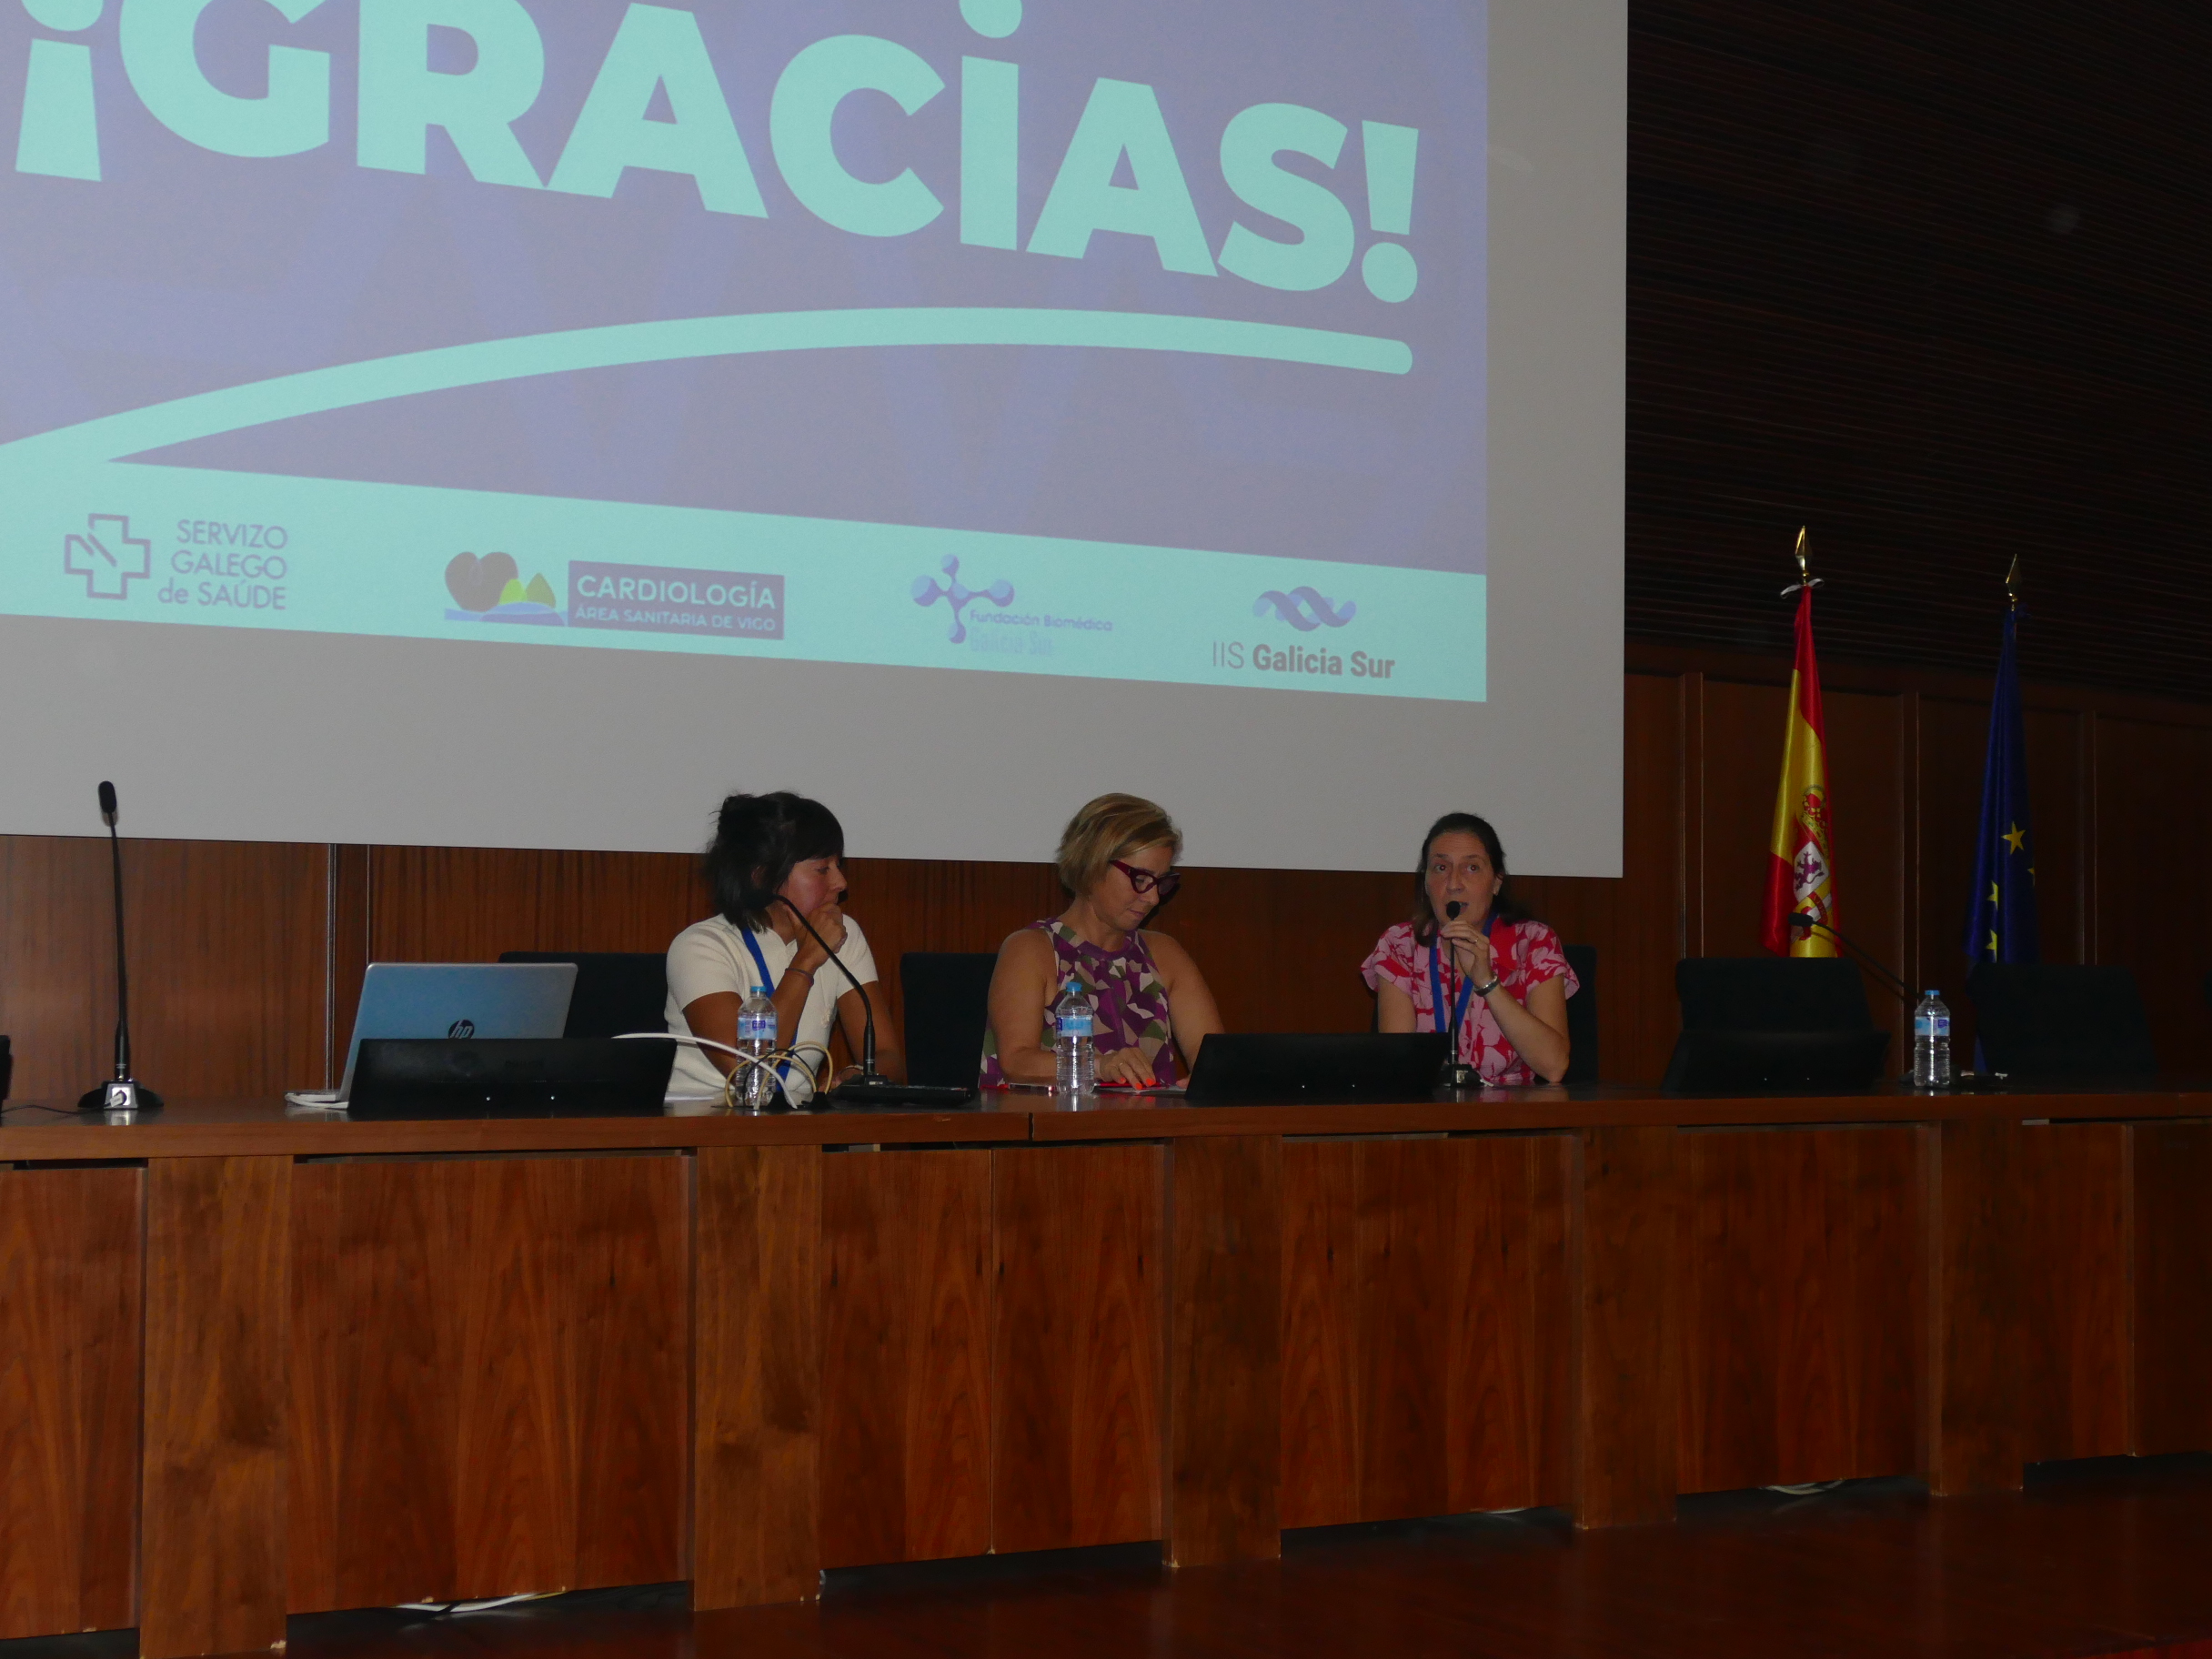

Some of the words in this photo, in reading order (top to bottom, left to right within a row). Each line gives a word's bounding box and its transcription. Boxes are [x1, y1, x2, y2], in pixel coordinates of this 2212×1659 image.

[176, 519, 288, 549] SERVIZO
[171, 550, 287, 579] GALEGO
[157, 576, 189, 604] de
[197, 579, 287, 610] SAÚDE
[577, 575, 776, 608] CARDIOLOGÍA
[623, 608, 708, 628] SANITARIA
[712, 614, 733, 629] DE
[737, 617, 777, 632] VIGO
[1212, 641, 1245, 669] IIS
[1252, 643, 1343, 676] Galicia
[1350, 650, 1395, 679] Sur
[448, 1020, 474, 1039] hp
